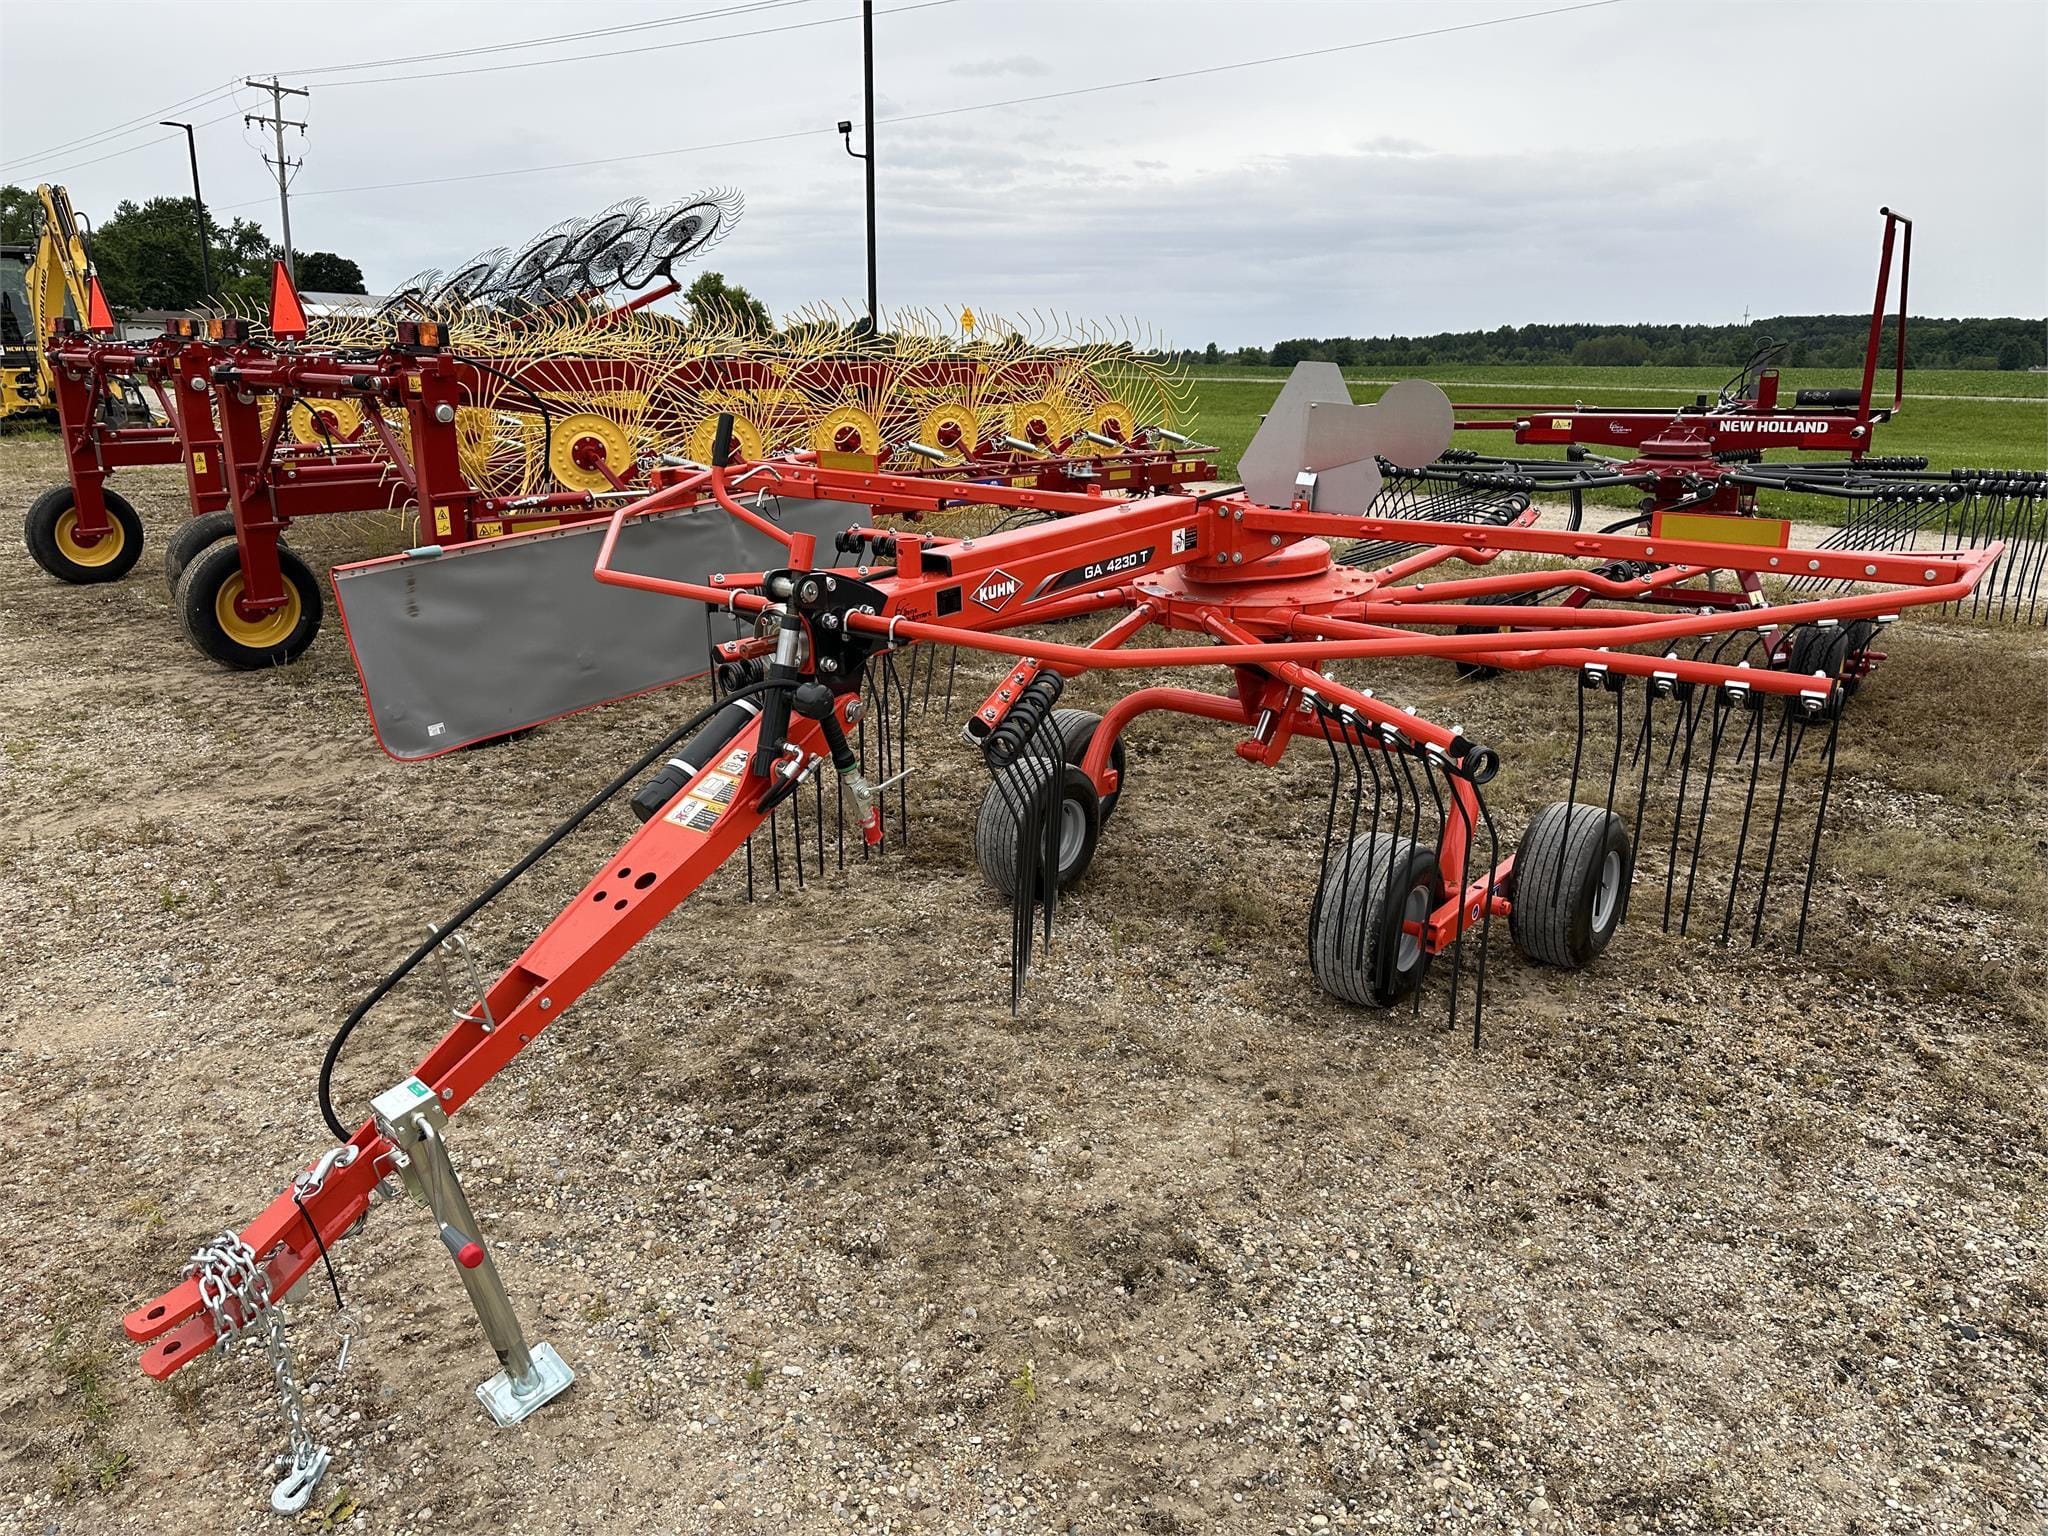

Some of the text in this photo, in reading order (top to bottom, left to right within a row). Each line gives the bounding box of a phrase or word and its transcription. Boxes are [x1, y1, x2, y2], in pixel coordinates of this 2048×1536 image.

[1720, 420, 1829, 433] NEW HOLLAND
[1084, 550, 1149, 579] GA 4230 T
[979, 580, 1016, 602] KUHN
